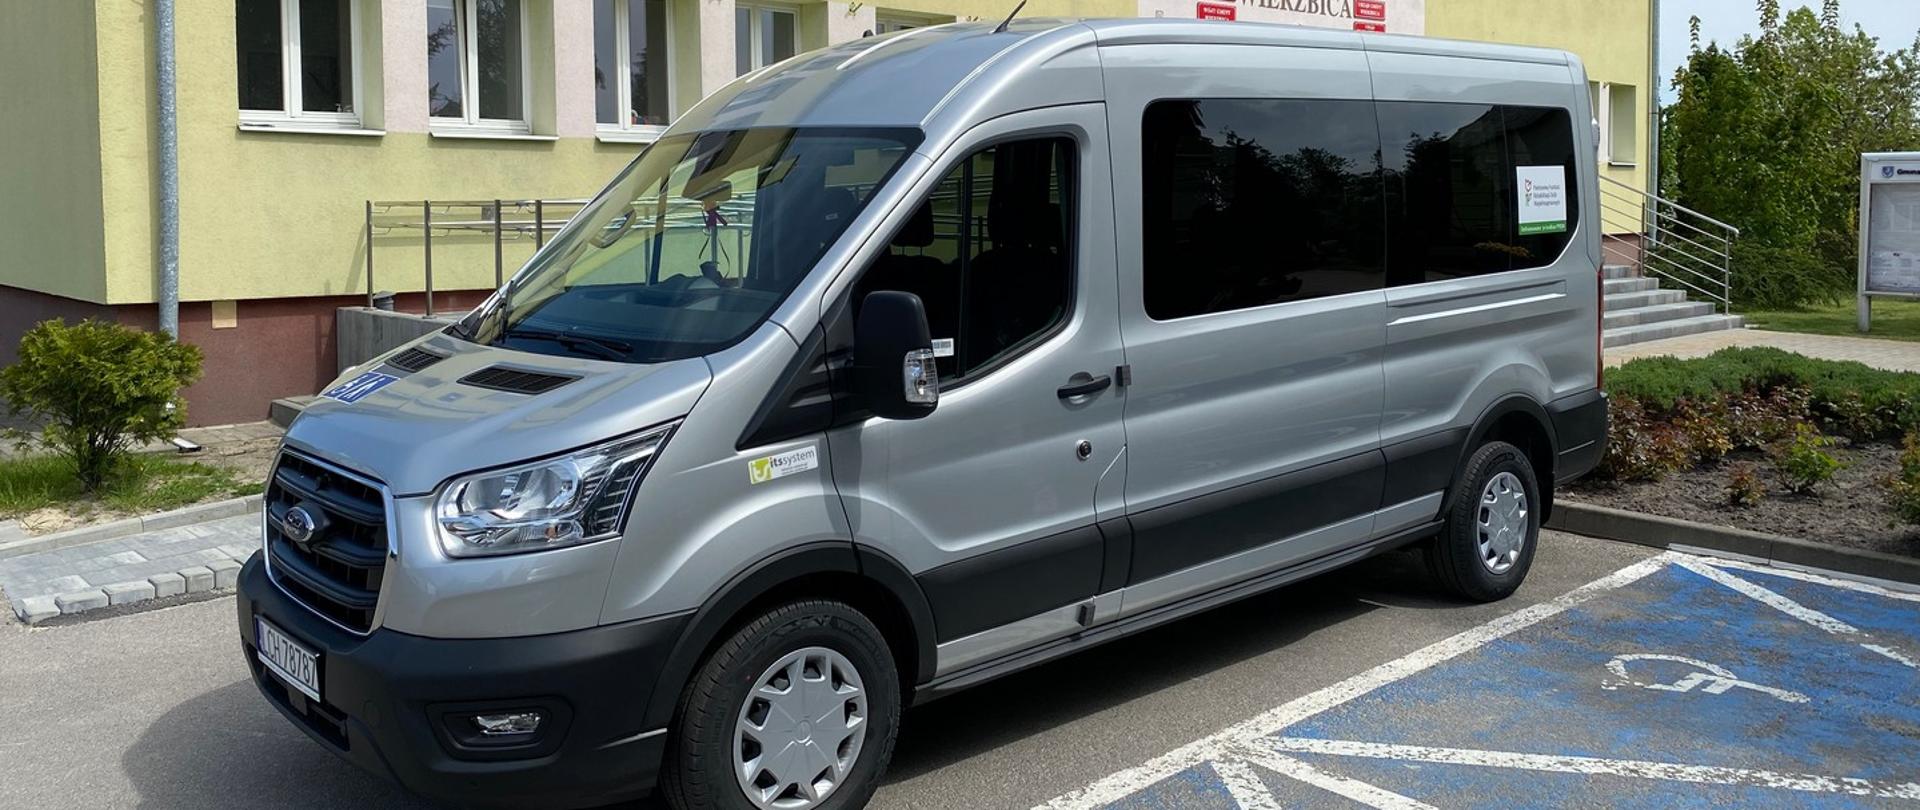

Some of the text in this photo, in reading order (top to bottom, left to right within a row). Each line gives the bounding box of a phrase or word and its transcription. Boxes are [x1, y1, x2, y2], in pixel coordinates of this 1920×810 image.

[1240, 0, 1352, 18] RZBICA
[769, 450, 815, 468] itssystem
[281, 638, 316, 688] 78787
